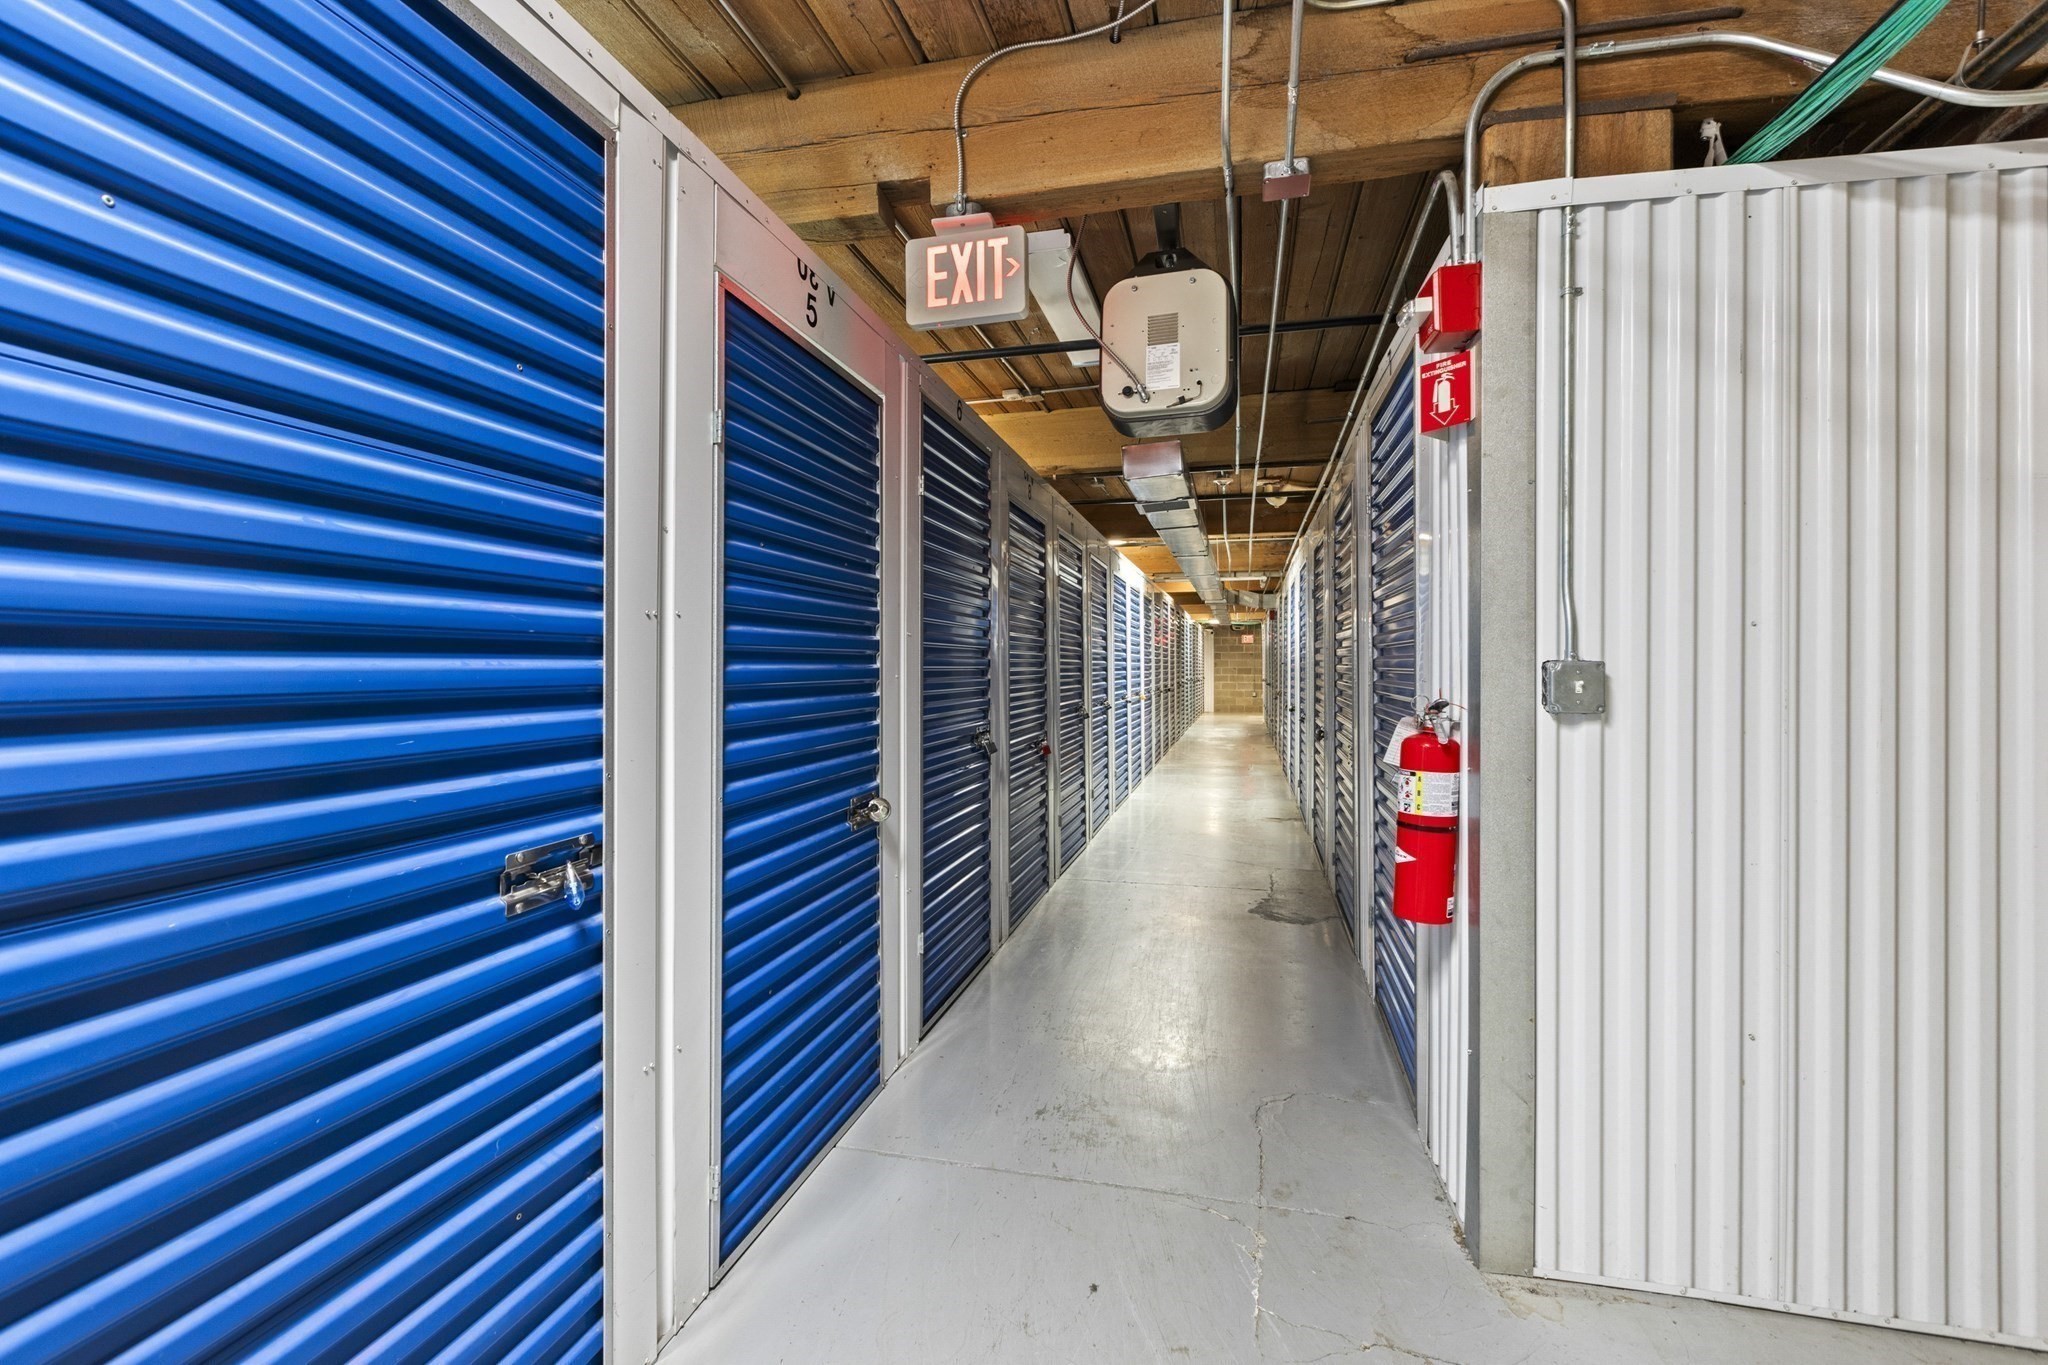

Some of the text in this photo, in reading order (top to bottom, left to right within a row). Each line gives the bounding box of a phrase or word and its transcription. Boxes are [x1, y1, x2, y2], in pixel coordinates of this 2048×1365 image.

[926, 237, 1009, 308] EXIT
[806, 292, 818, 328] 5
[1421, 361, 1467, 379] EXTINGUISHER
[1435, 360, 1452, 369] FIRE
